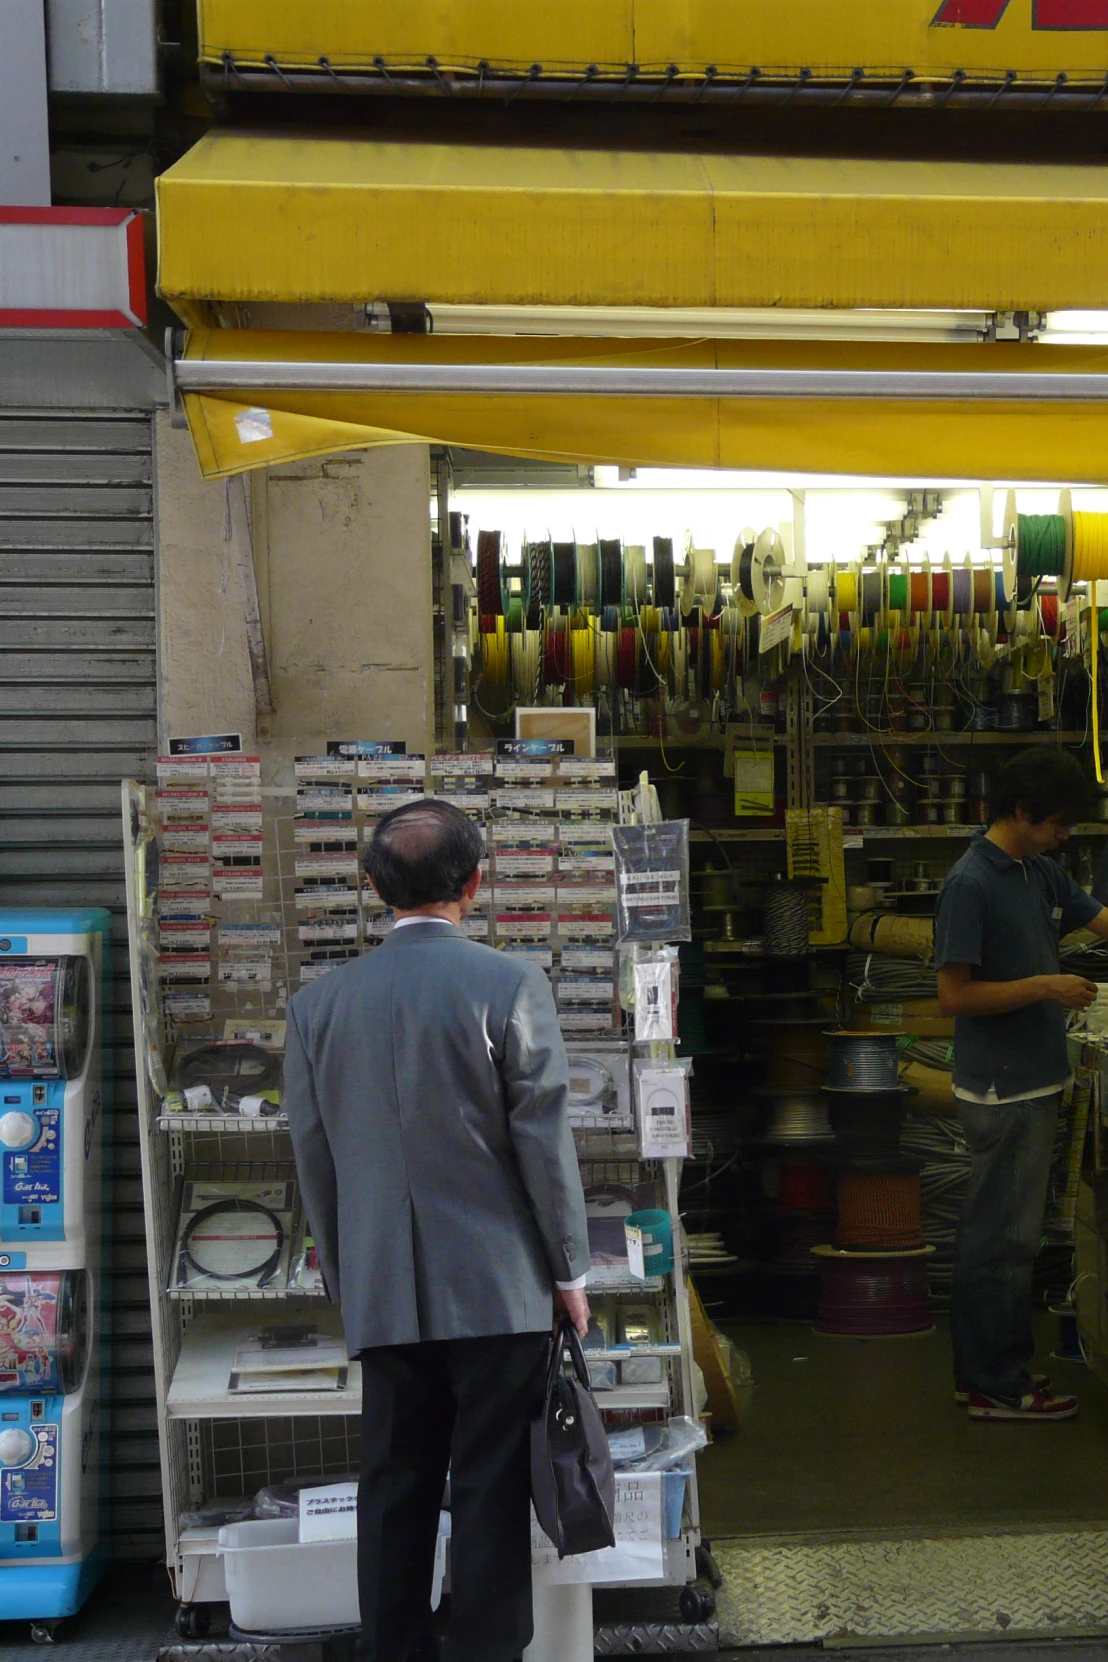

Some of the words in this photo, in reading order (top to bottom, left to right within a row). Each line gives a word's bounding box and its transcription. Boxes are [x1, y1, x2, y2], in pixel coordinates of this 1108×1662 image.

[339, 744, 392, 754] 電源ケーブル
[504, 743, 565, 752] ラインケーブル
